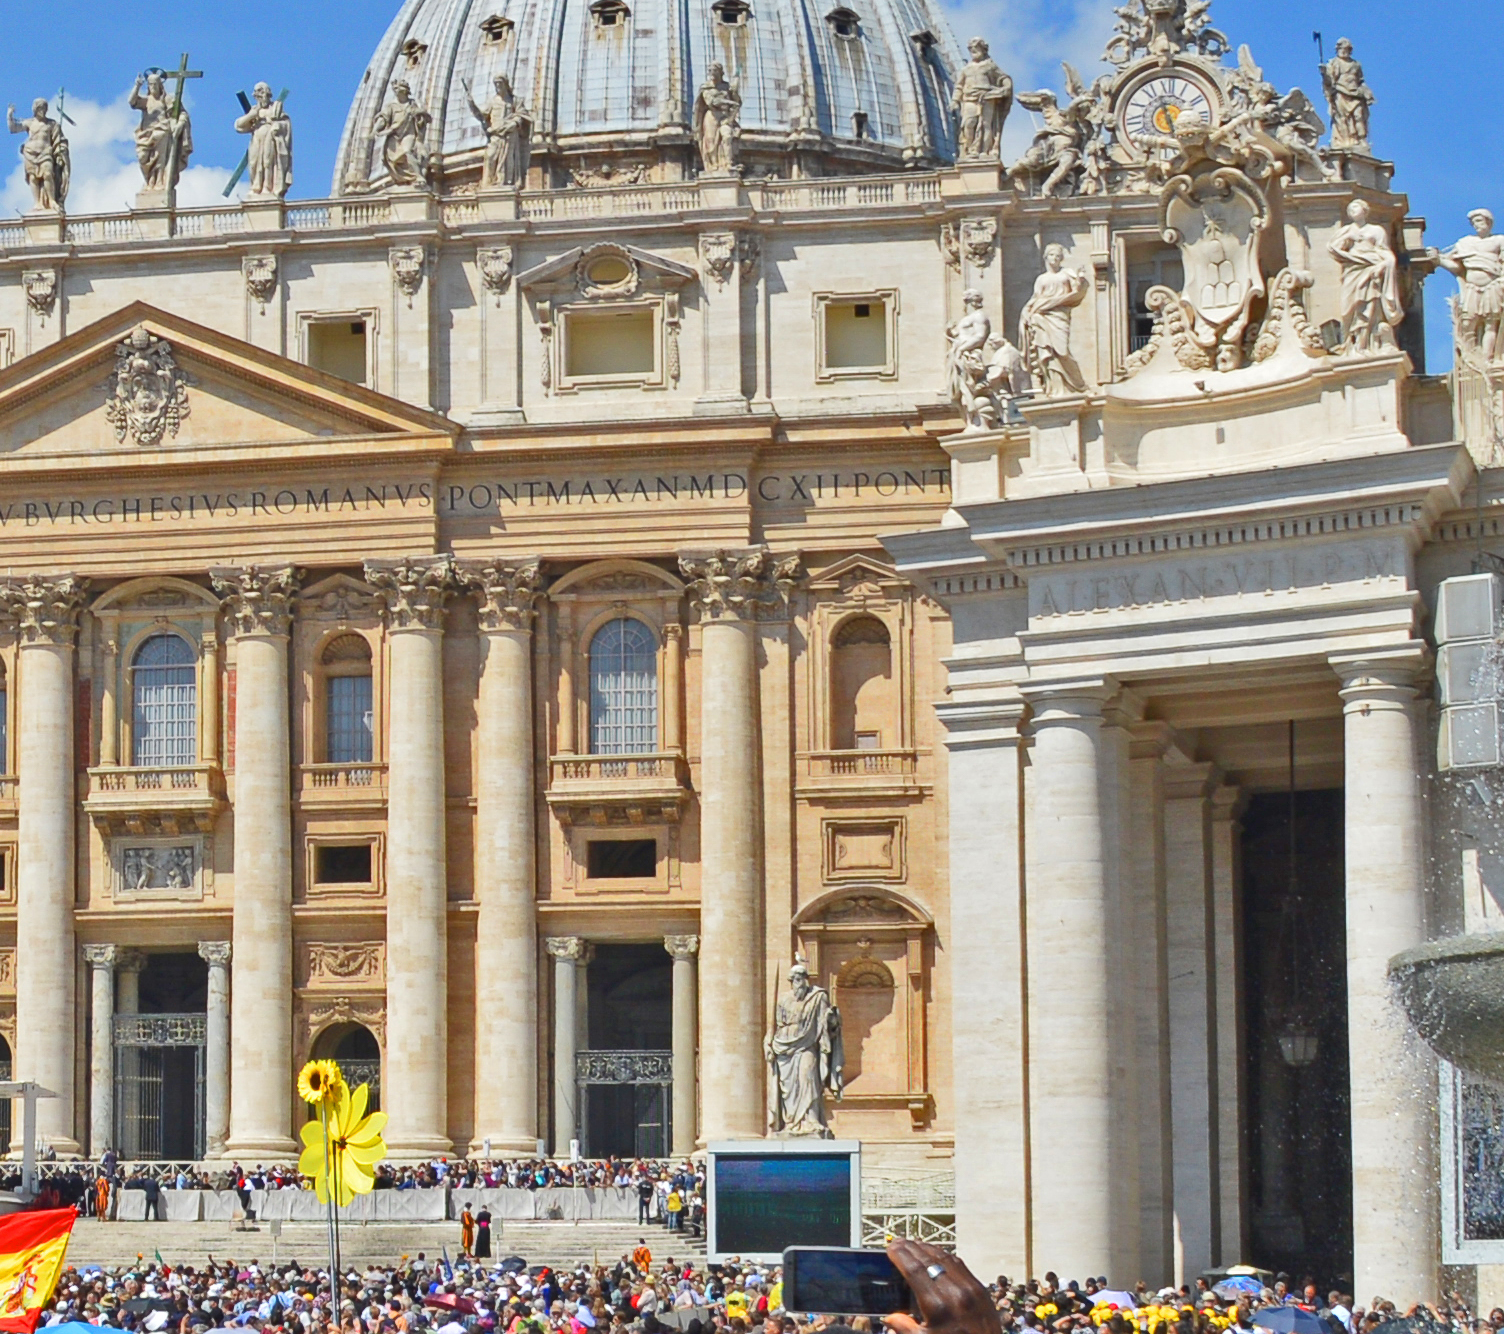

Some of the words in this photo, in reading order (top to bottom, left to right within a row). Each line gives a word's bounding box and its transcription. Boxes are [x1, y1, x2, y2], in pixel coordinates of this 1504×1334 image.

[24, 493, 239, 526] BVRGHESIVS
[251, 482, 431, 517] ROMANVS
[447, 481, 543, 511] PONT
[545, 478, 624, 507] MAX
[631, 475, 681, 503] AN
